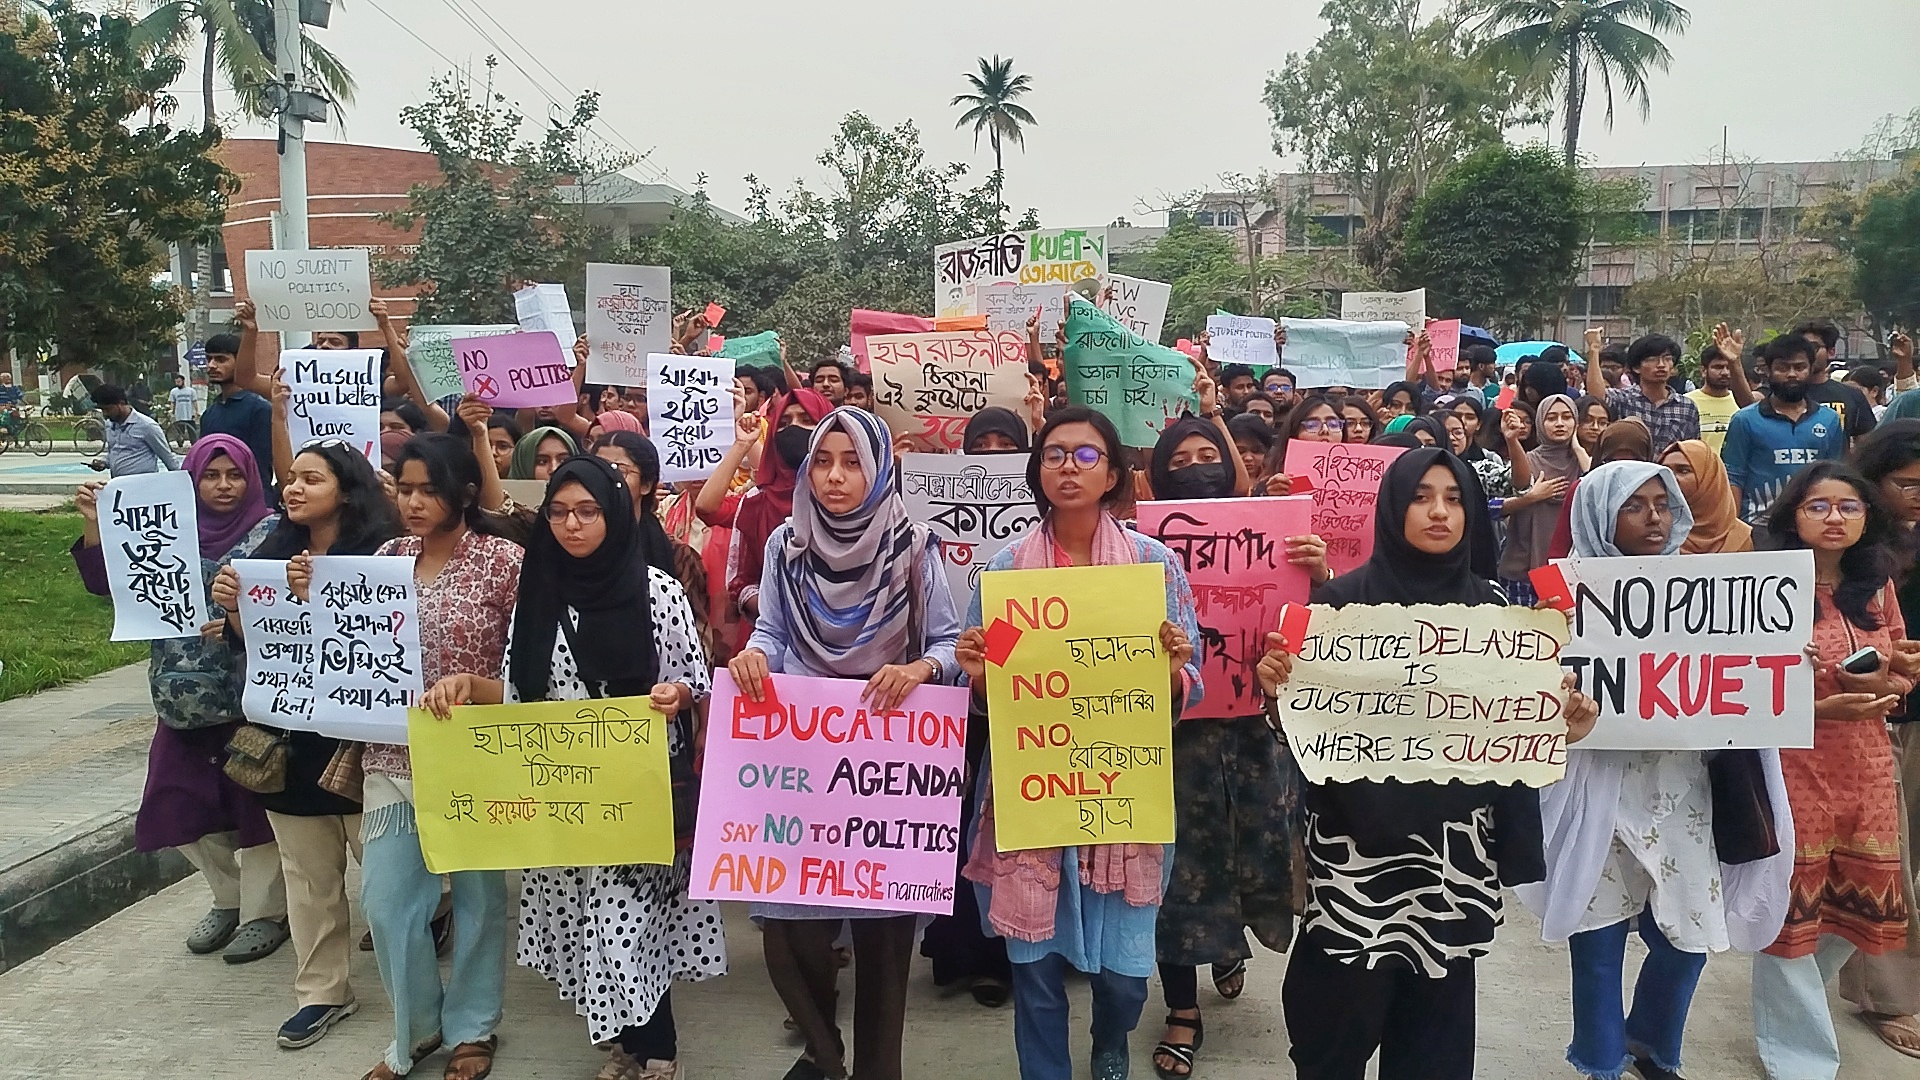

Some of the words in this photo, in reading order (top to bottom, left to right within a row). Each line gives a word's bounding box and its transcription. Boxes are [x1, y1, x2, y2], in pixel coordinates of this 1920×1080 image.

[260, 261, 286, 279] NO
[295, 259, 352, 275] STUDENT
[940, 234, 1026, 284] রাজনীতি
[1019, 261, 1097, 284] তোমাকে
[288, 282, 350, 293] POLITICS,
[1108, 278, 1140, 302] EW
[264, 304, 291, 320] NO
[304, 302, 361, 320] BLOOD
[1230, 318, 1251, 329] NO
[1208, 326, 1244, 338] STUDENT
[462, 350, 488, 373] NO
[924, 329, 1029, 369] রাজনীতির
[1222, 347, 1260, 361] KUET
[295, 356, 374, 385] Masud
[508, 364, 571, 391] POLITICS
[660, 365, 719, 395] মাসুদ
[921, 363, 995, 392] ঠিকানা
[1128, 355, 1182, 381] বিজ্ঞান
[293, 391, 331, 418] you
[336, 384, 381, 407] better
[876, 372, 910, 411] এই
[1082, 385, 1109, 405] চর্চা
[308, 416, 355, 436] leave
[1774, 449, 1819, 465] EEE
[113, 490, 178, 540] মাসুদ
[121, 534, 175, 572] তুই
[1157, 512, 1276, 575] নিরাপদ
[376, 584, 407, 604] কেন
[1575, 576, 1655, 639] NO
[1664, 575, 1797, 635] POLITICS
[1006, 596, 1069, 631] NO
[1065, 635, 1156, 669] ছাত্রদল
[1298, 634, 1412, 662] JUSTICE
[1415, 619, 1561, 661] DELAYED
[372, 637, 413, 683] তুই
[1402, 661, 1438, 686] IS
[328, 686, 372, 711] কথা
[1012, 671, 1070, 701] NO
[1561, 656, 1626, 716] IN
[1638, 652, 1802, 720] KUET
[1070, 689, 1155, 719] ছাত্রশিবির
[1290, 687, 1416, 716] JUSTICE
[1425, 690, 1562, 723] DENIED
[469, 707, 651, 755] ছাত্ররাজনীতির
[731, 695, 967, 748] EDUCATION
[1017, 723, 1071, 750] NO
[1294, 732, 1395, 763] WHERE
[1401, 735, 1434, 761] IS
[1443, 733, 1567, 765] JUSTICE
[522, 754, 600, 787] ঠিকানা
[738, 763, 814, 793] OVER
[827, 757, 964, 797] AGENDA
[1021, 771, 1122, 802] ONLY
[445, 791, 479, 824] এই
[484, 794, 541, 825] কুয়েটে
[545, 802, 590, 825] হবে
[601, 802, 633, 821] না
[1075, 797, 1136, 837] ছাত্র
[721, 821, 758, 843] SAY
[764, 813, 803, 846] NO
[810, 824, 842, 845] TO
[844, 817, 959, 853] POLITICS
[708, 853, 786, 894] AND
[799, 857, 887, 900] FALSE
